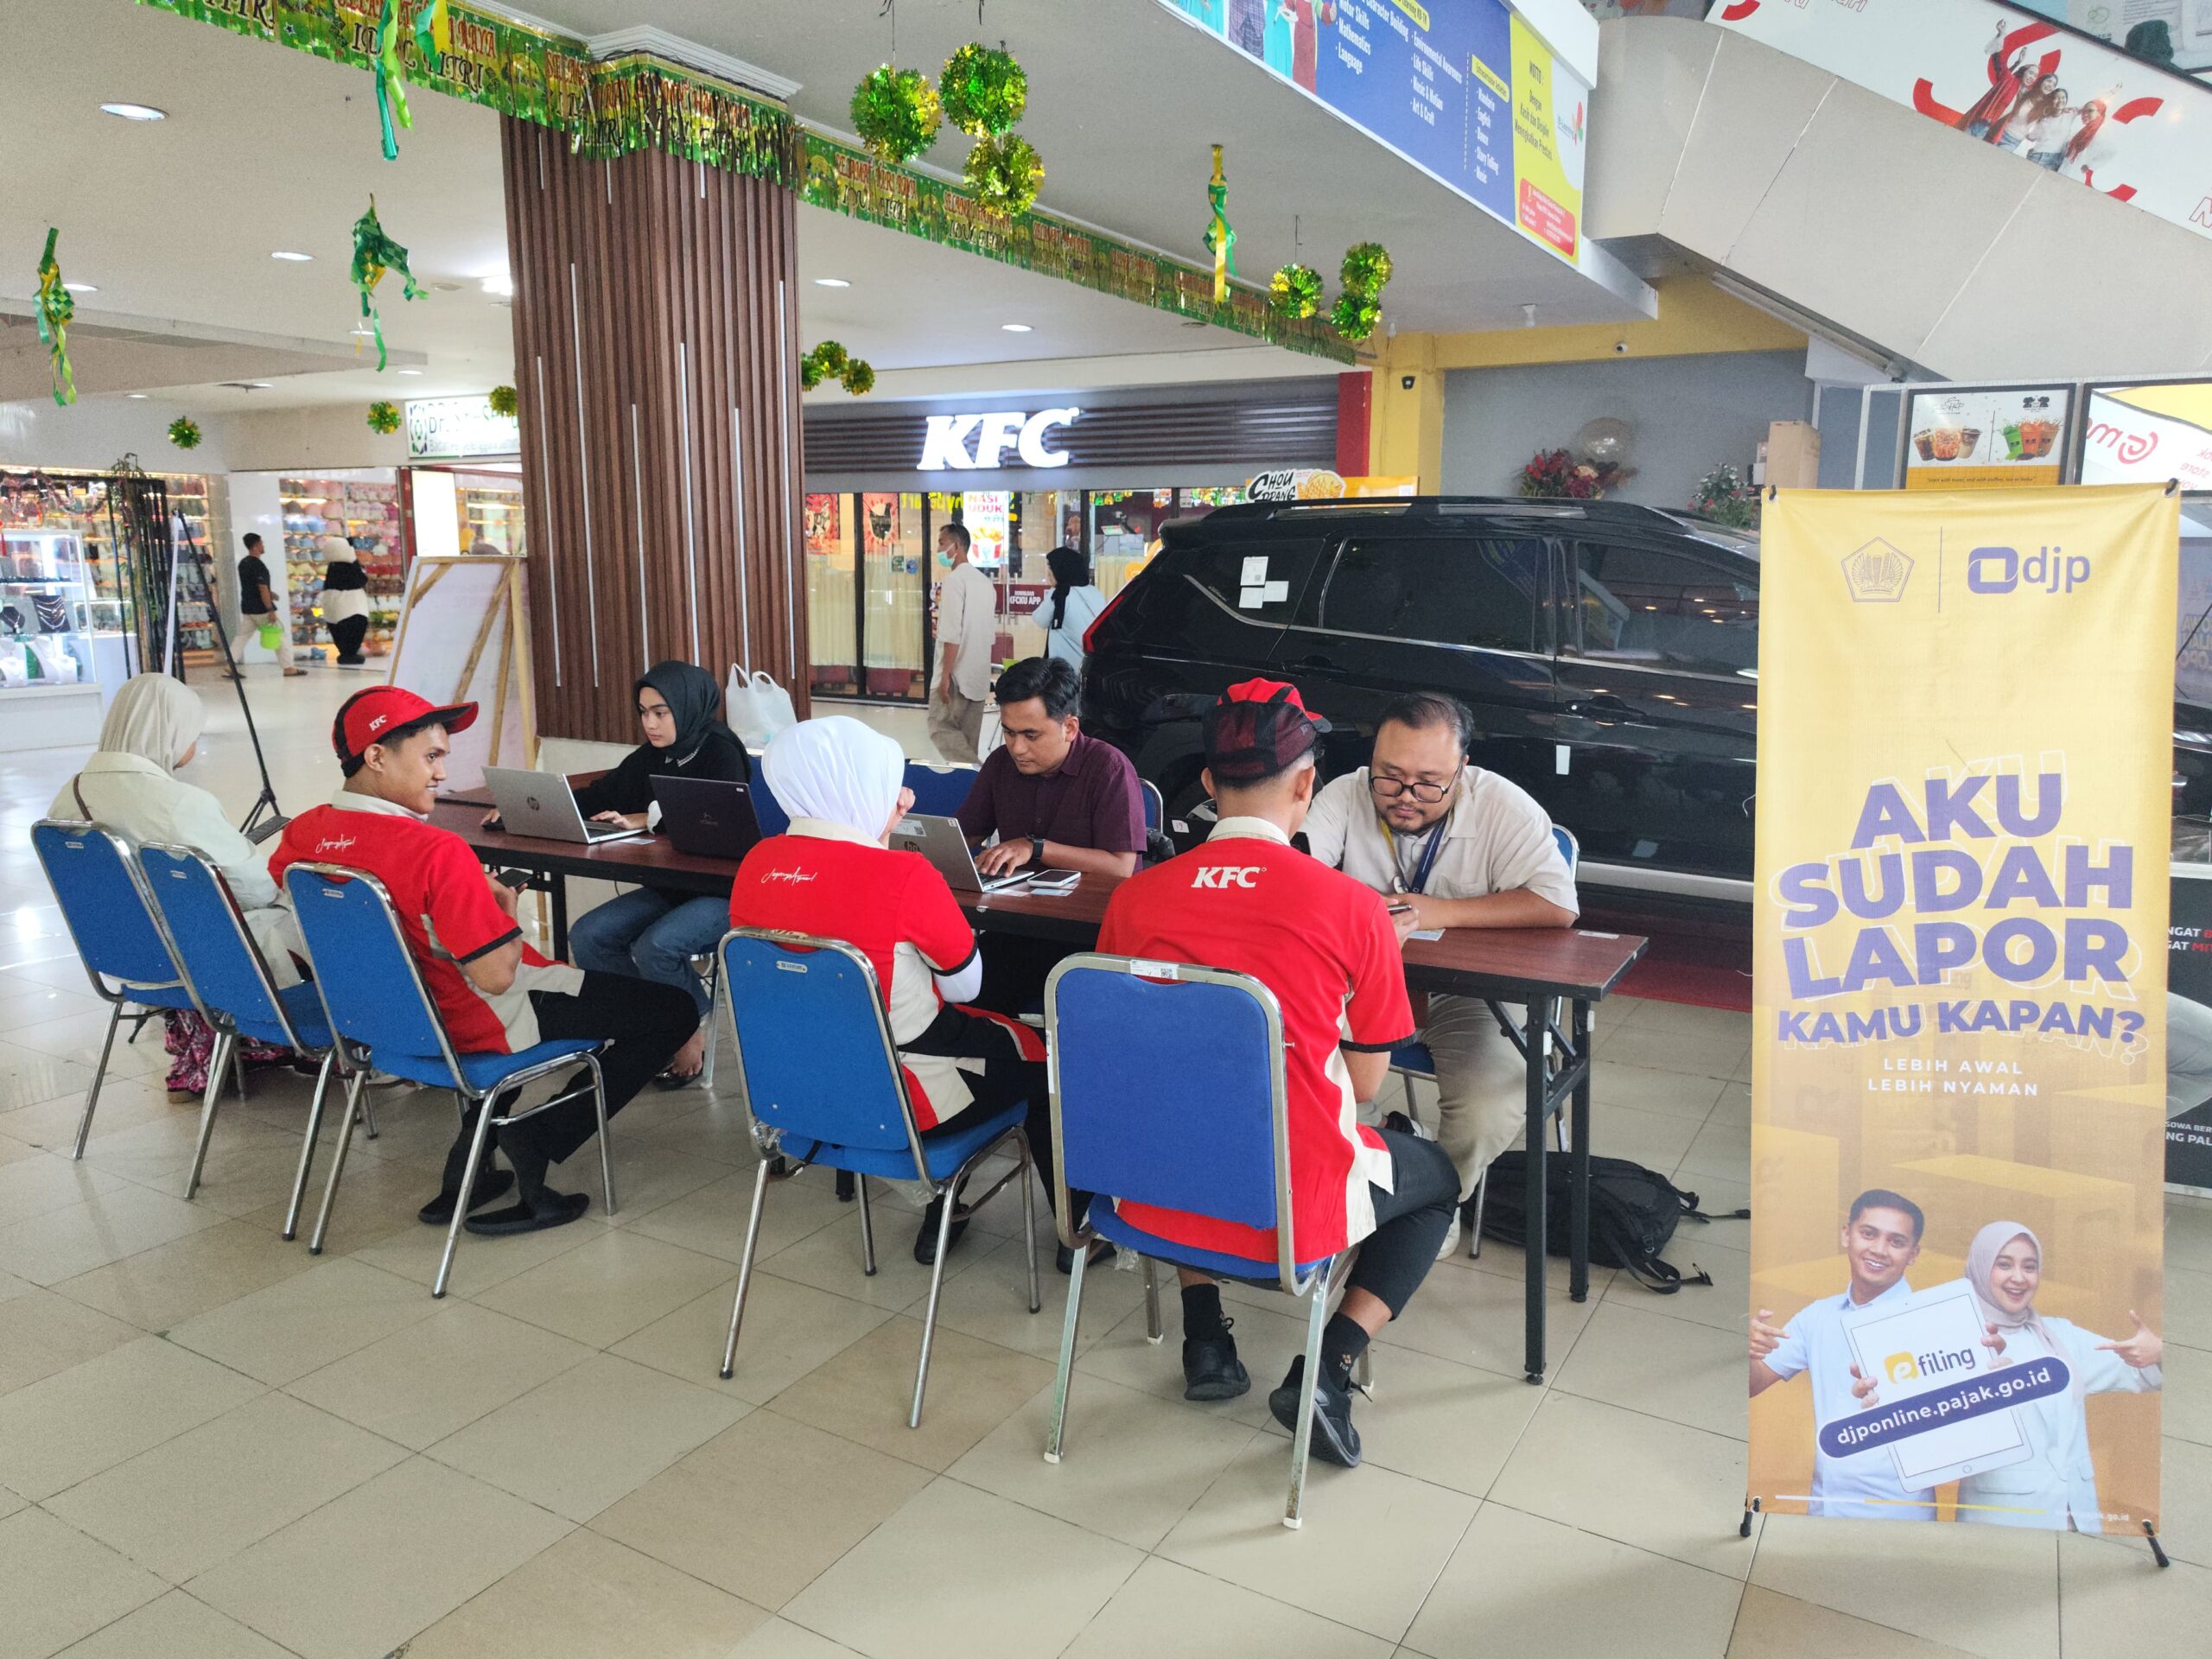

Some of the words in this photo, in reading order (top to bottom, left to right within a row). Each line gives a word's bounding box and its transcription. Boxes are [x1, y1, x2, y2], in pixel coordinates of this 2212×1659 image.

[1356, 5, 1370, 30] Skills
[1390, 10, 1408, 42] Building
[1338, 17, 1371, 55] Mathematics
[1338, 41, 1363, 75] Language
[1413, 53, 1421, 73] Life
[1421, 60, 1433, 82] Skills
[1414, 31, 1442, 67] Environmental
[1442, 56, 1462, 84] Awareness
[1413, 75, 1426, 98] Music
[1478, 87, 1495, 113] Mandarin
[1520, 102, 1530, 122] Kasih
[1529, 89, 1542, 111] Dengan
[1478, 106, 1491, 129] English
[1477, 126, 1489, 146] Dance
[1477, 146, 1487, 167] Story
[917, 409, 1074, 471] KFC
[1249, 471, 1294, 499] CHOU
[969, 494, 998, 504] NASI
[969, 505, 1003, 513] UDUK
[2023, 546, 2091, 594] djp
[1029, 596, 1042, 605] APP
[369, 715, 387, 732] KFC
[1851, 772, 2063, 850] AKU
[1191, 867, 1262, 888] KFC
[1777, 844, 2133, 928] SUDAH
[1782, 917, 2129, 1001] LAPOR
[1777, 1003, 1923, 1044] KAMU
[1937, 1000, 2145, 1044] KAPAN?
[1883, 1058, 1948, 1072] LEBIH
[1959, 1060, 2023, 1075] AWAL
[1867, 1078, 1934, 1094] LEBIH
[1943, 1081, 2038, 1096] NYAMAN
[1837, 1367, 2051, 1446] djponline.pajak.go.id
